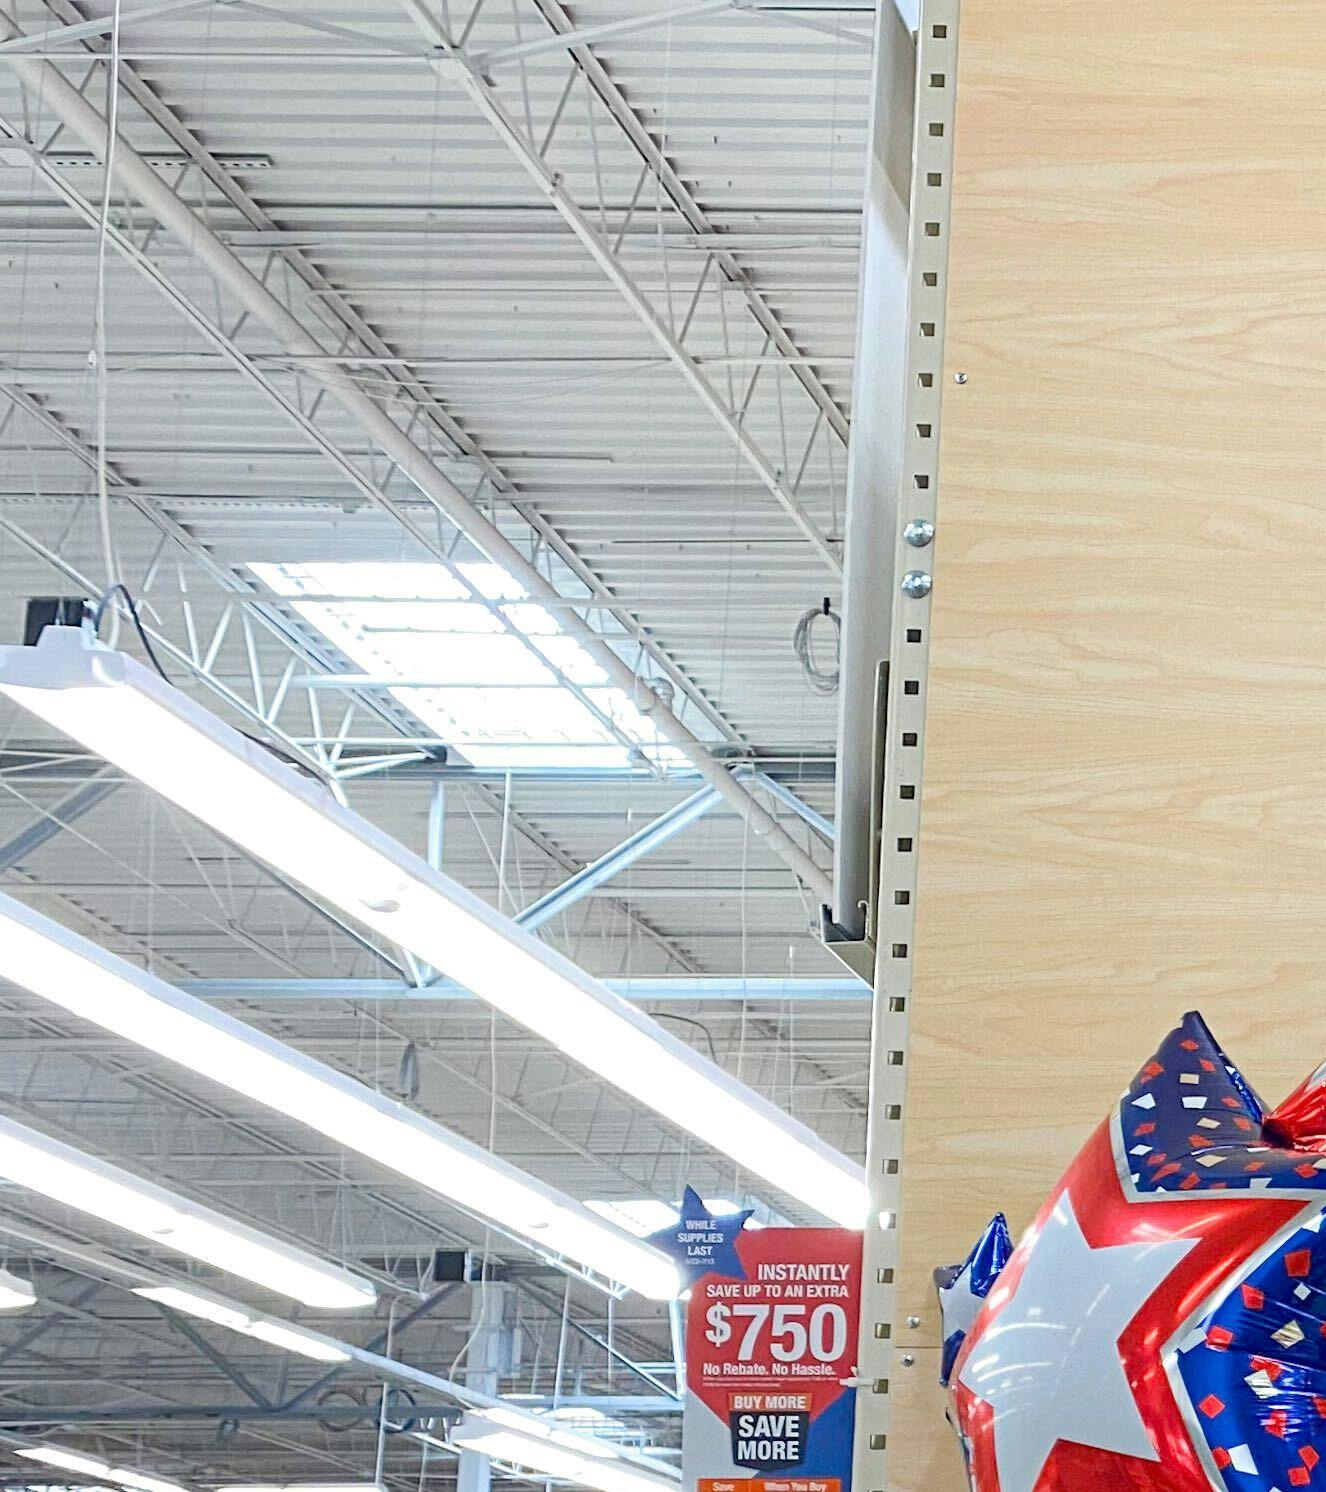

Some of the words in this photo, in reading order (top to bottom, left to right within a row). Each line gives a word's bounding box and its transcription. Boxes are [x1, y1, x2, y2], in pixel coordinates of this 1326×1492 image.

[685, 1220, 717, 1230] WHILE
[677, 1233, 724, 1243] SUPPLIES
[687, 1246, 713, 1256] LAST
[757, 1263, 850, 1281] INSTANTLY
[706, 1285, 740, 1298] SAVE
[744, 1285, 761, 1297] UP
[765, 1285, 781, 1297] TO
[784, 1285, 803, 1297] AN
[806, 1285, 849, 1298] EXTRA
[705, 1301, 847, 1363] $750
[703, 1363, 720, 1375] No
[723, 1363, 769, 1375] Rebate.
[772, 1363, 788, 1375] No
[791, 1363, 836, 1375] Hassle.
[734, 1396, 761, 1409] BUY
[765, 1395, 806, 1409] MORE
[738, 1415, 799, 1438] SAVE
[738, 1440, 799, 1461] MORE
[712, 1482, 735, 1491] Save
[790, 1482, 807, 1491] You
[809, 1482, 827, 1492] Buy
